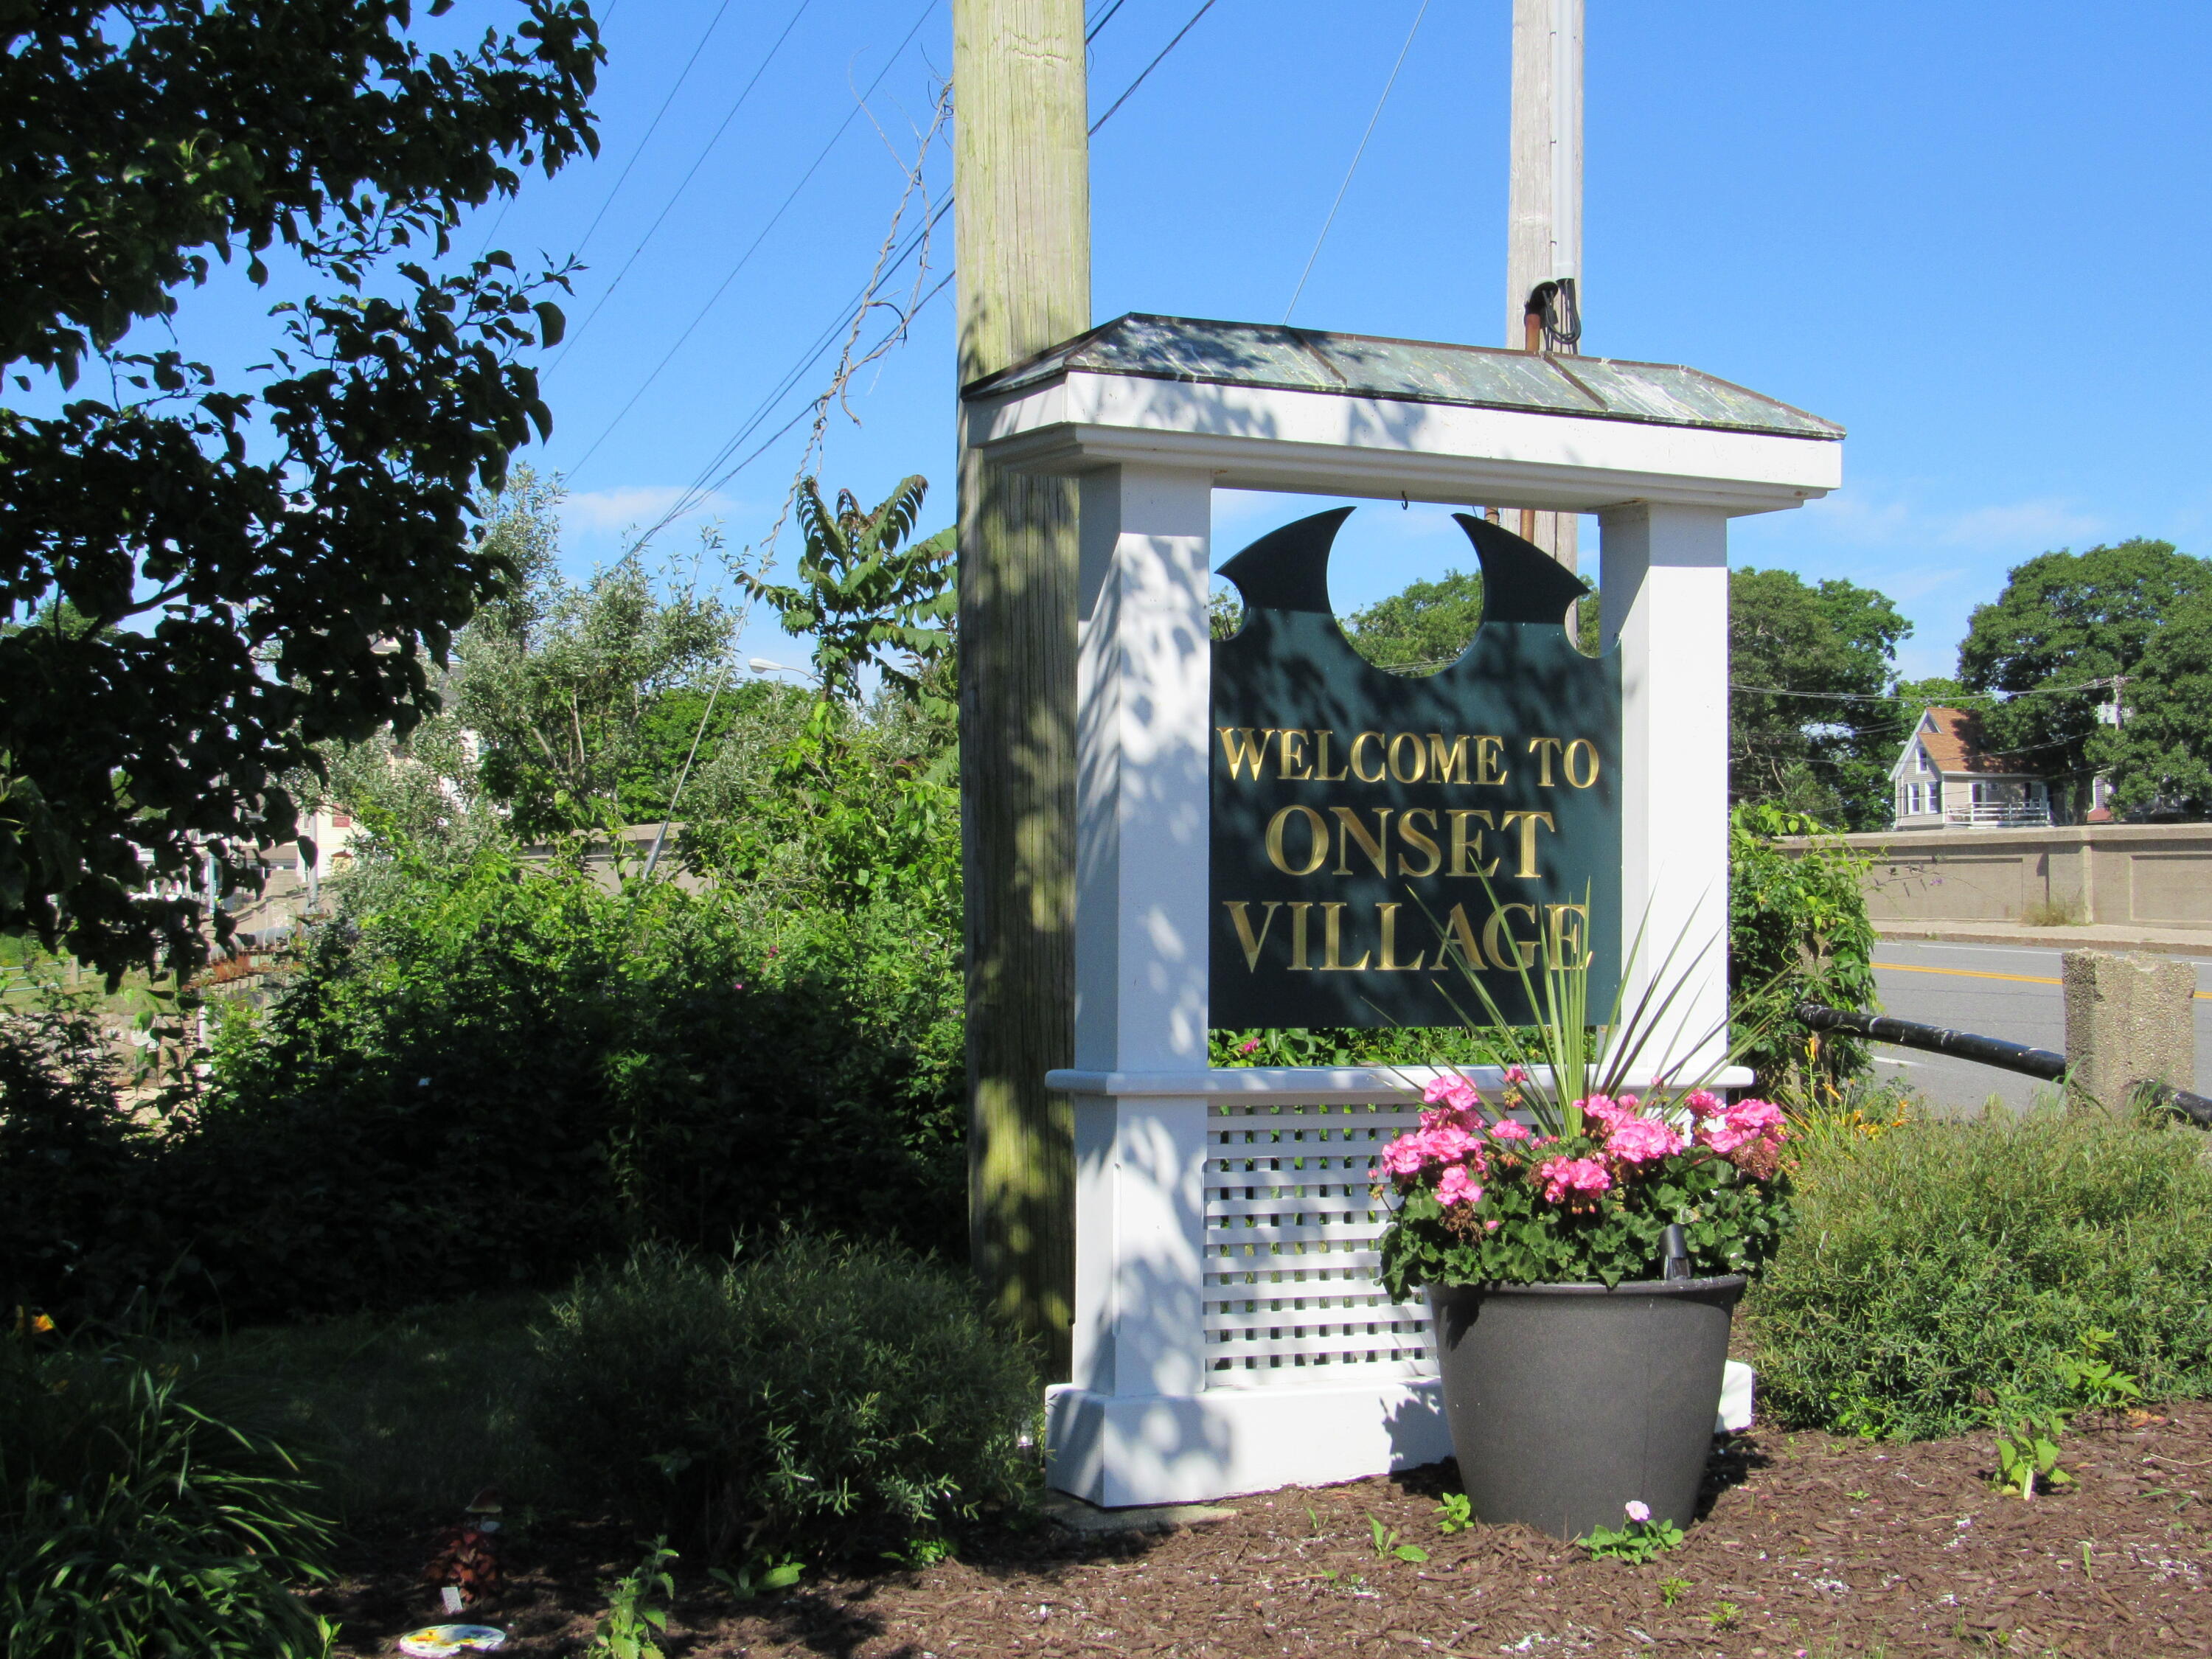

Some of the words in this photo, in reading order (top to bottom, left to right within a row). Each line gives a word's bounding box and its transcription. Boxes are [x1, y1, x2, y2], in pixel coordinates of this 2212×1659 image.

[1216, 726, 1509, 785] WELCOME
[1528, 737, 1600, 789] TO
[1265, 804, 1556, 879] ONSET
[1222, 900, 1594, 973] VILLAGE
